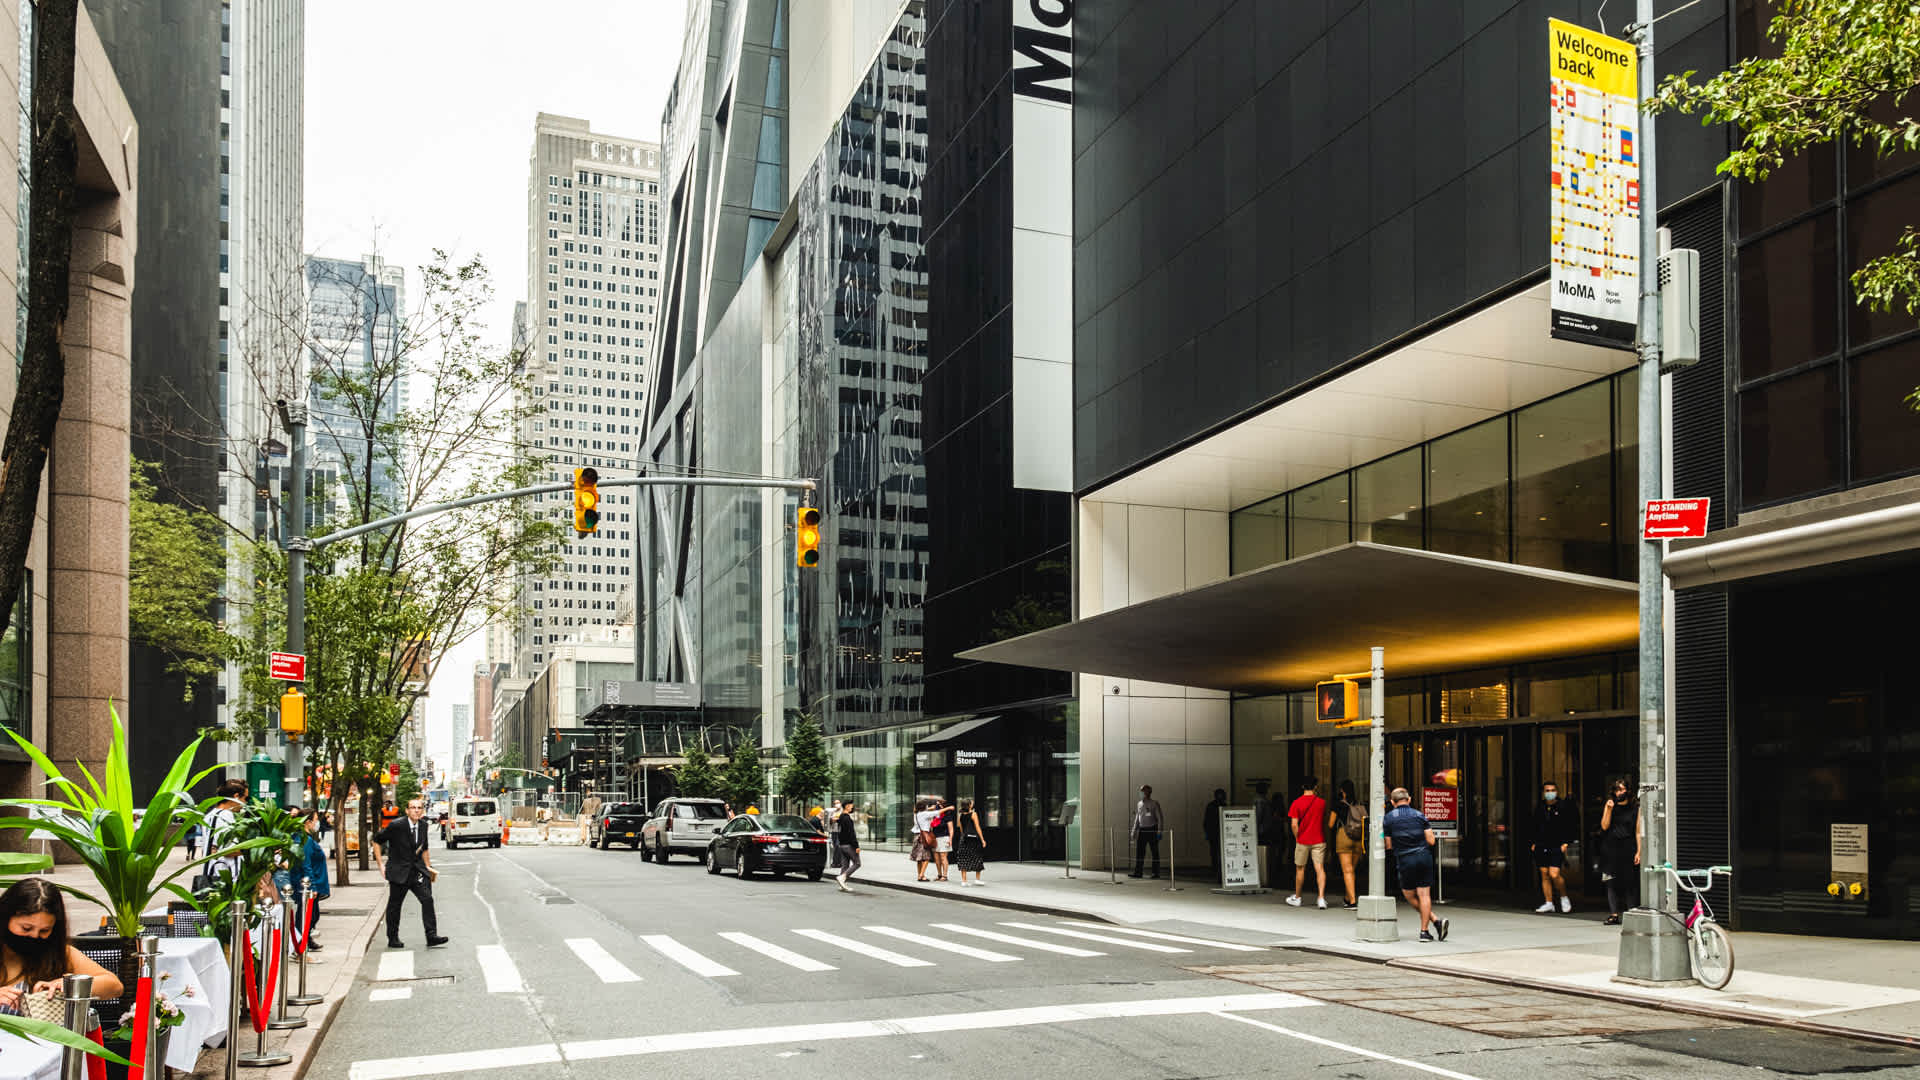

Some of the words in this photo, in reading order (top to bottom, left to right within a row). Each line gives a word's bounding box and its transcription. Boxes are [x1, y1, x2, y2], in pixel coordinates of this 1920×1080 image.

[1556, 30, 1629, 67] Welcome
[1558, 52, 1595, 79] back
[1559, 280, 1596, 301] MoMA
[1606, 289, 1619, 297] Now
[1649, 504, 1660, 512] NO
[1661, 502, 1698, 512] STANDING
[1649, 512, 1679, 522] Anytime
[956, 750, 988, 758] Museum
[956, 757, 977, 765] Store
